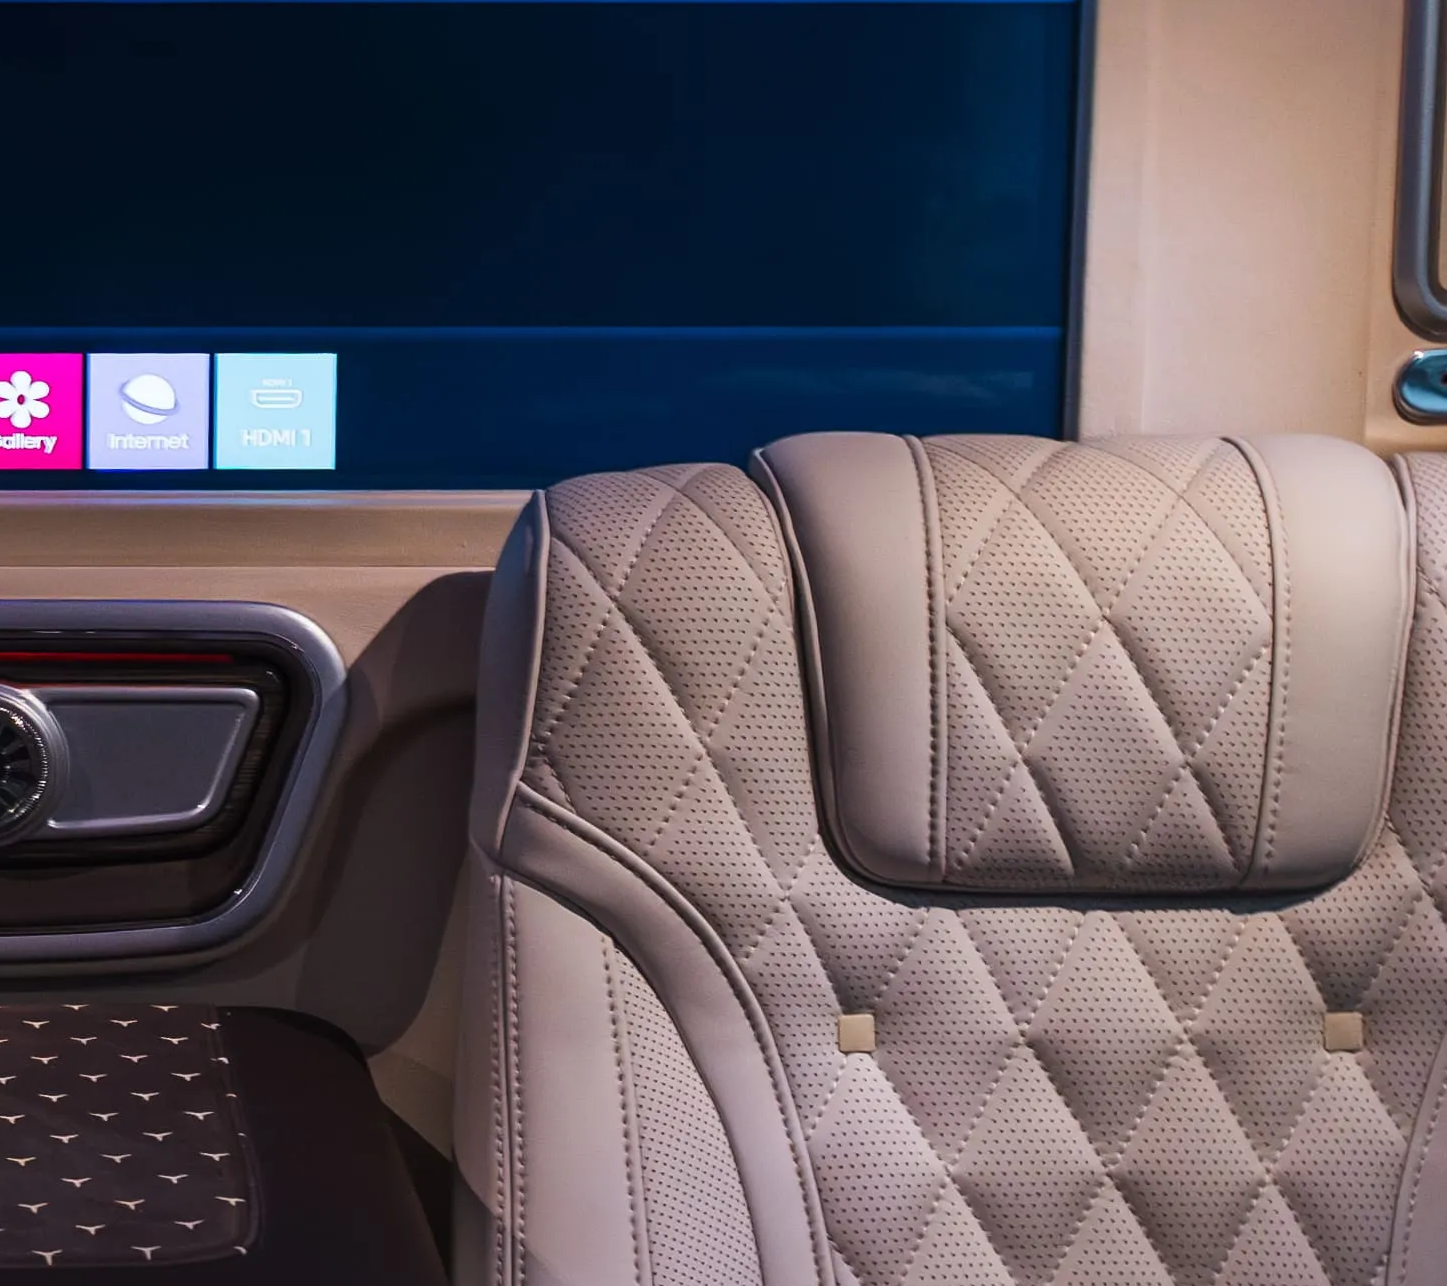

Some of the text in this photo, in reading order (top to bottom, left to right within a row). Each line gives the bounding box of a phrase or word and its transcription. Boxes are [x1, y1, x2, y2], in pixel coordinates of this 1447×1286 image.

[109, 432, 190, 450] Internet
[241, 428, 311, 447] HDMI 1
